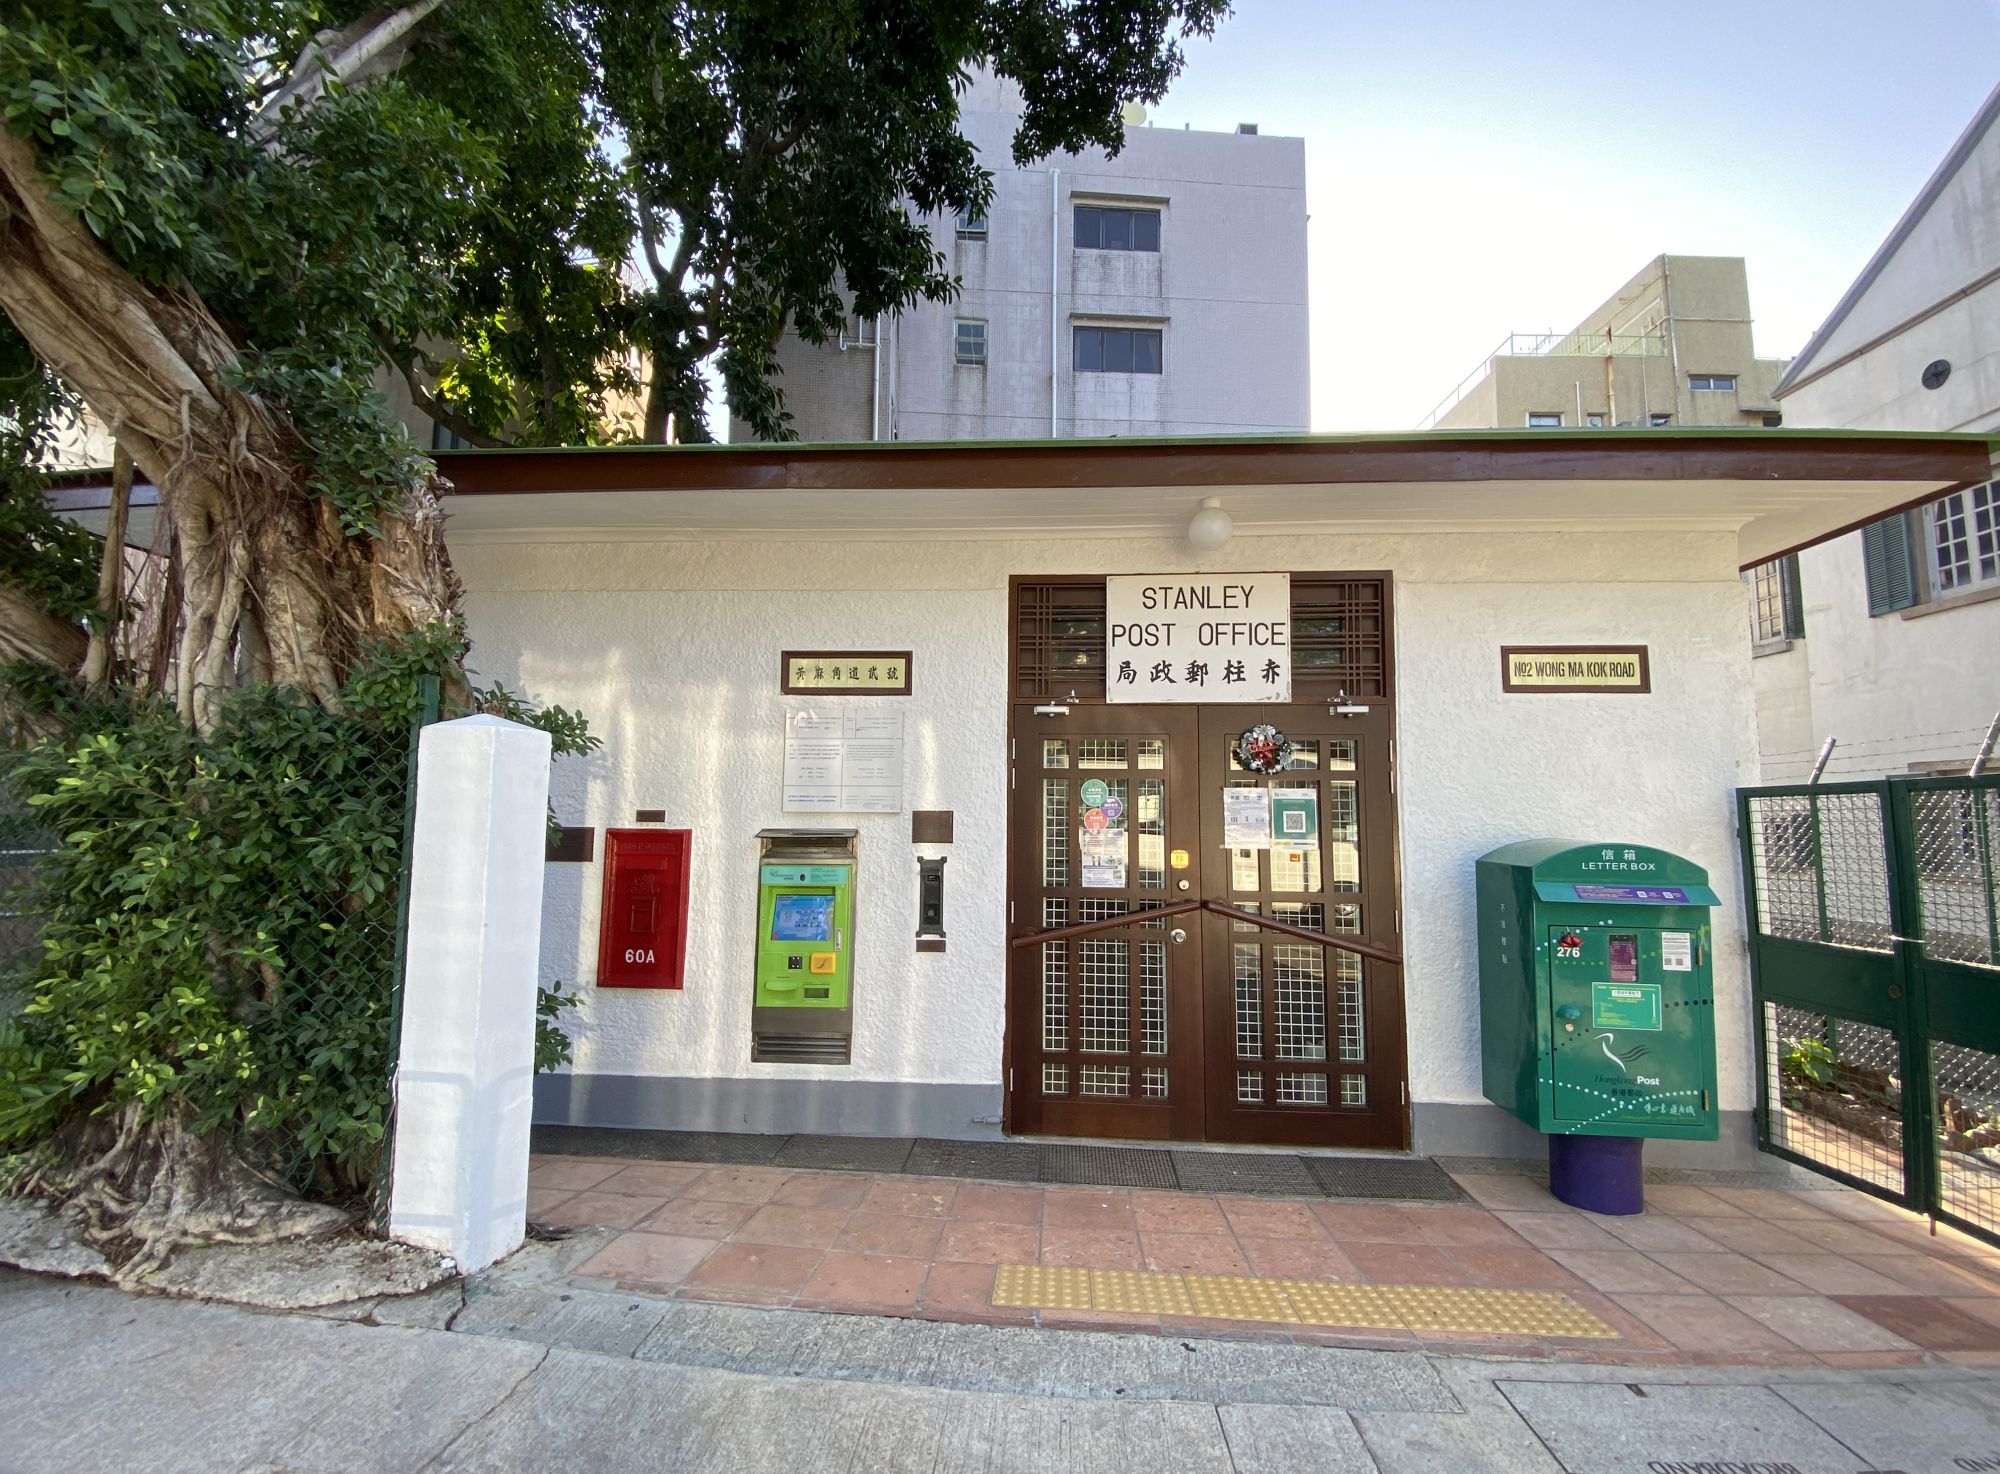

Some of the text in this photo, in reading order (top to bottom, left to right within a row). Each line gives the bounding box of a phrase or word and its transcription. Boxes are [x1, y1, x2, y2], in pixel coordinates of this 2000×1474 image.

[1142, 585, 1254, 609] STANLEY
[1112, 622, 1286, 647] POST OFFICE
[1535, 661, 1565, 677] WONG
[1568, 661, 1584, 677] MA
[1587, 661, 1608, 678] KOK
[1610, 661, 1635, 678] ROAD
[1601, 848, 1637, 861] 信箱
[1581, 861, 1656, 871] LETTER BOX
[625, 949, 655, 964] 60A
[1556, 946, 1580, 958] 276
[1636, 1075, 1660, 1086] Post
[1647, 1461, 1802, 1474] BROADBAND
